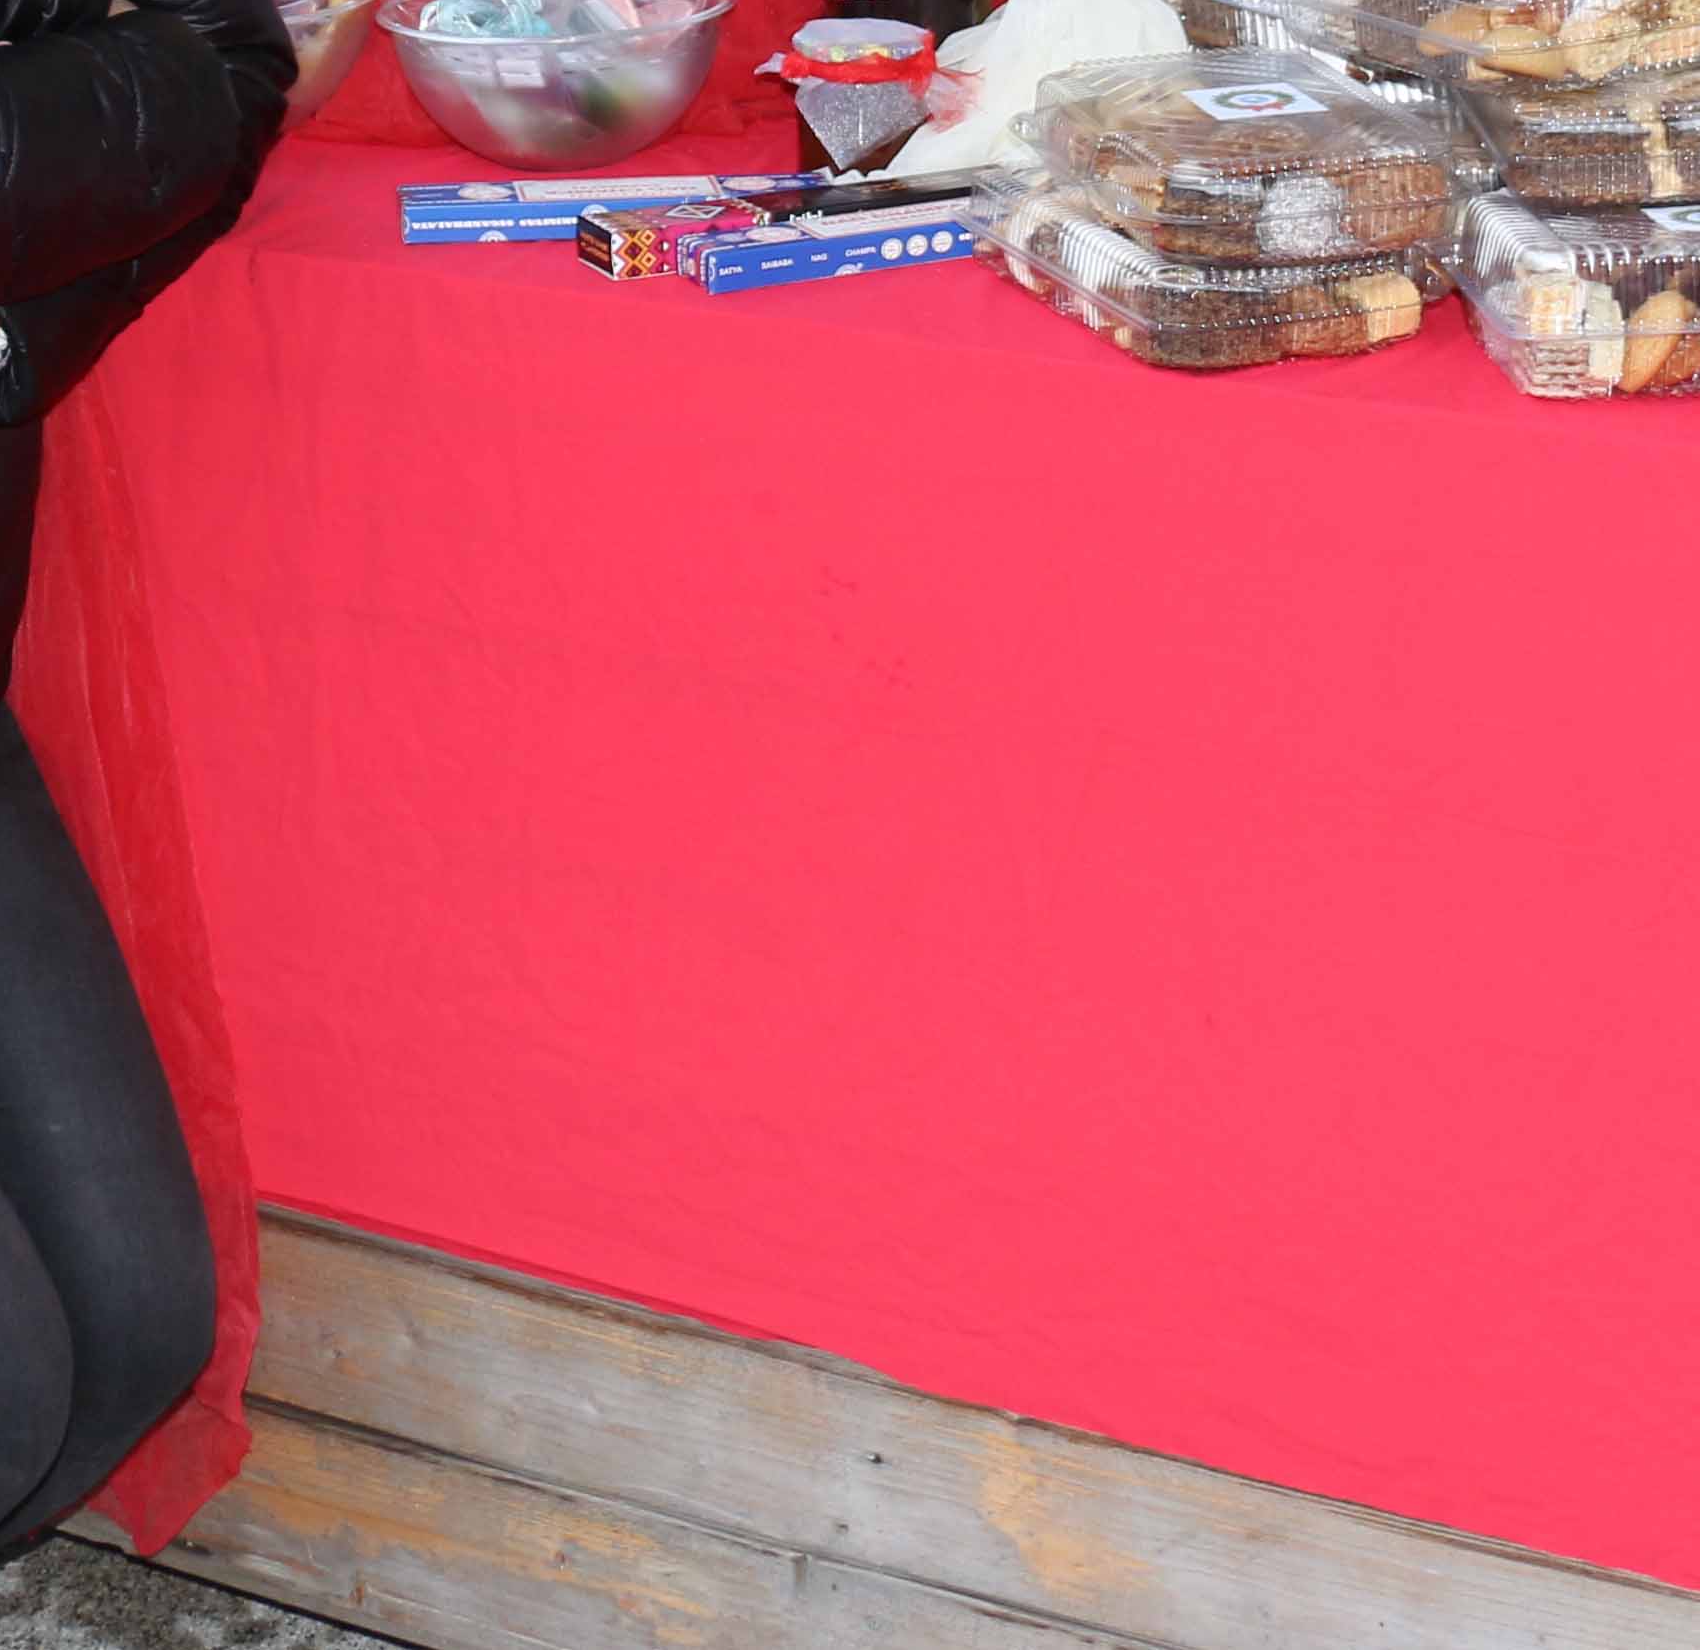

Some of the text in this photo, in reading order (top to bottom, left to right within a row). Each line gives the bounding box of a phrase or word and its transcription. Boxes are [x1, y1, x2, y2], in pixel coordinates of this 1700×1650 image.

[718, 265, 744, 277] SATYA
[810, 252, 828, 263] NAG
[844, 245, 877, 258] CHAMPA
